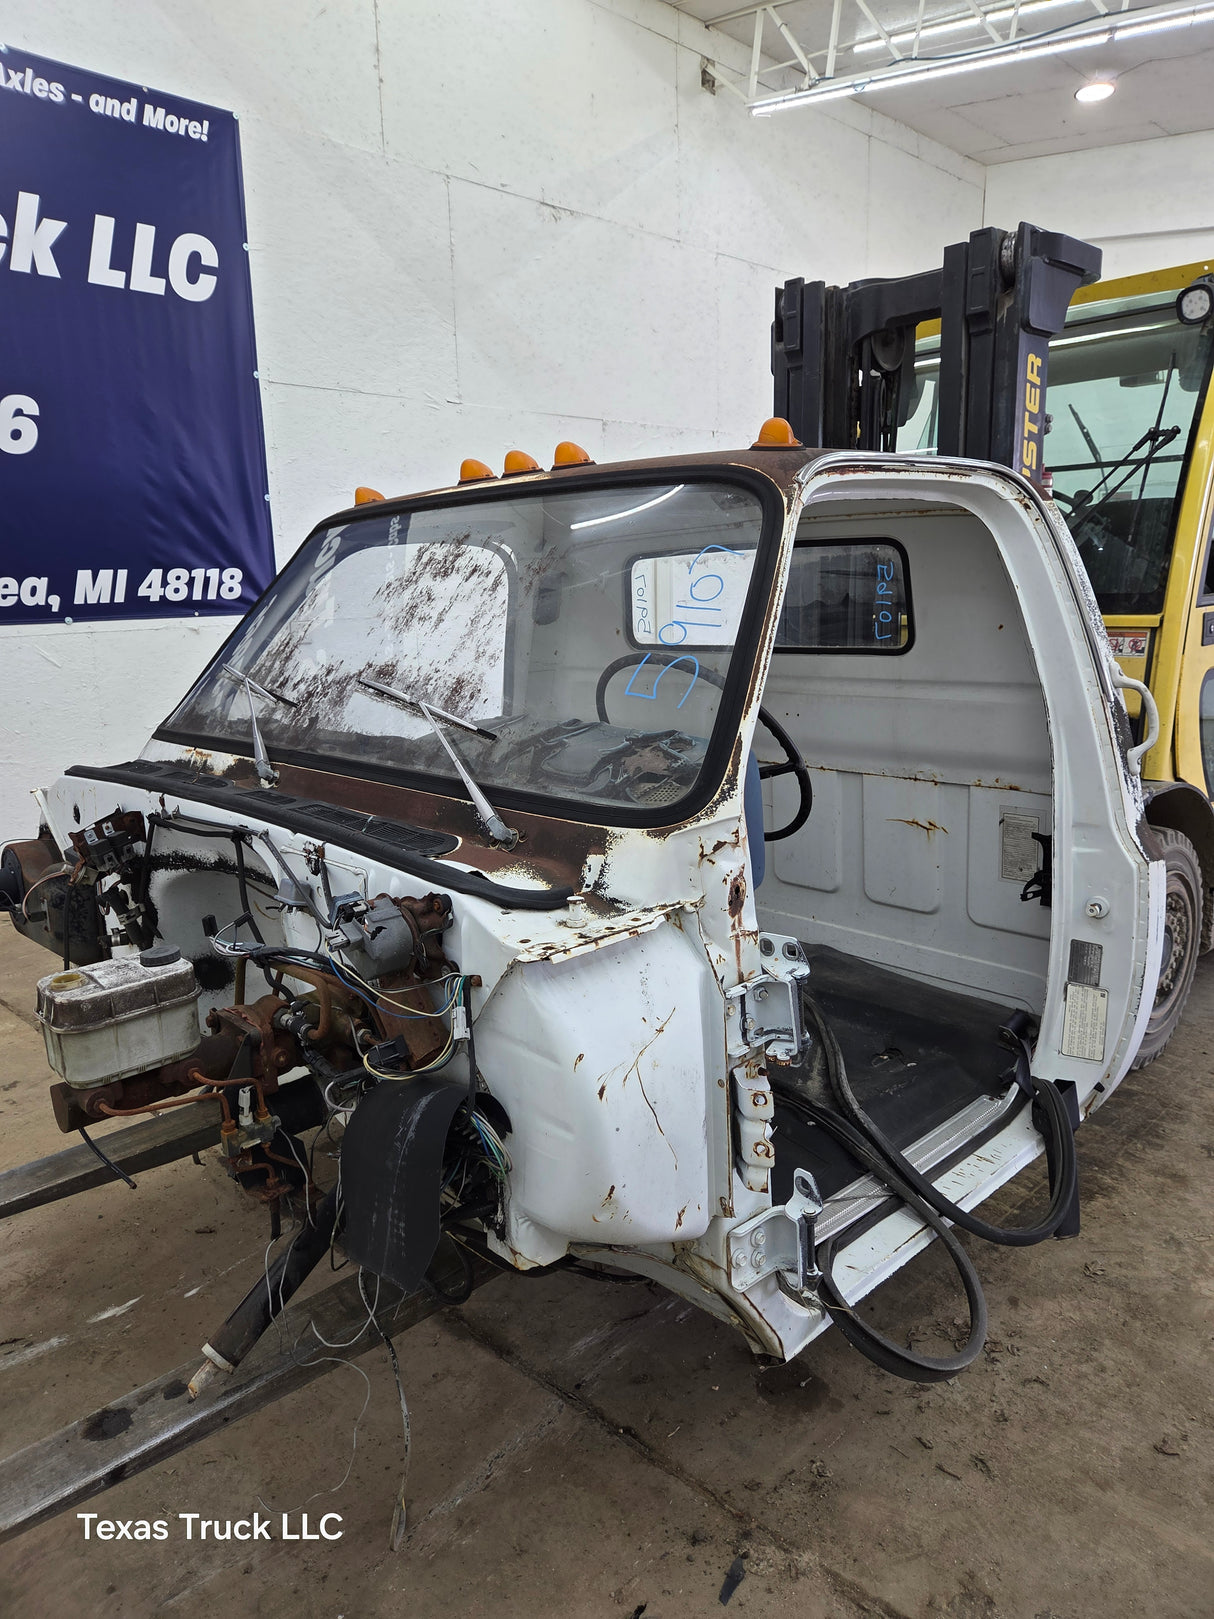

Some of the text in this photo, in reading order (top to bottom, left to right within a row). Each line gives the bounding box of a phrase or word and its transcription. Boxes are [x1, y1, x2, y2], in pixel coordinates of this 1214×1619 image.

[89, 93, 138, 123] and
[142, 103, 210, 142] More!
[0, 191, 219, 302] k LLC
[0, 395, 39, 455] 6
[74, 569, 127, 604] MI
[137, 567, 243, 602] 48118
[624, 544, 745, 710] 59107
